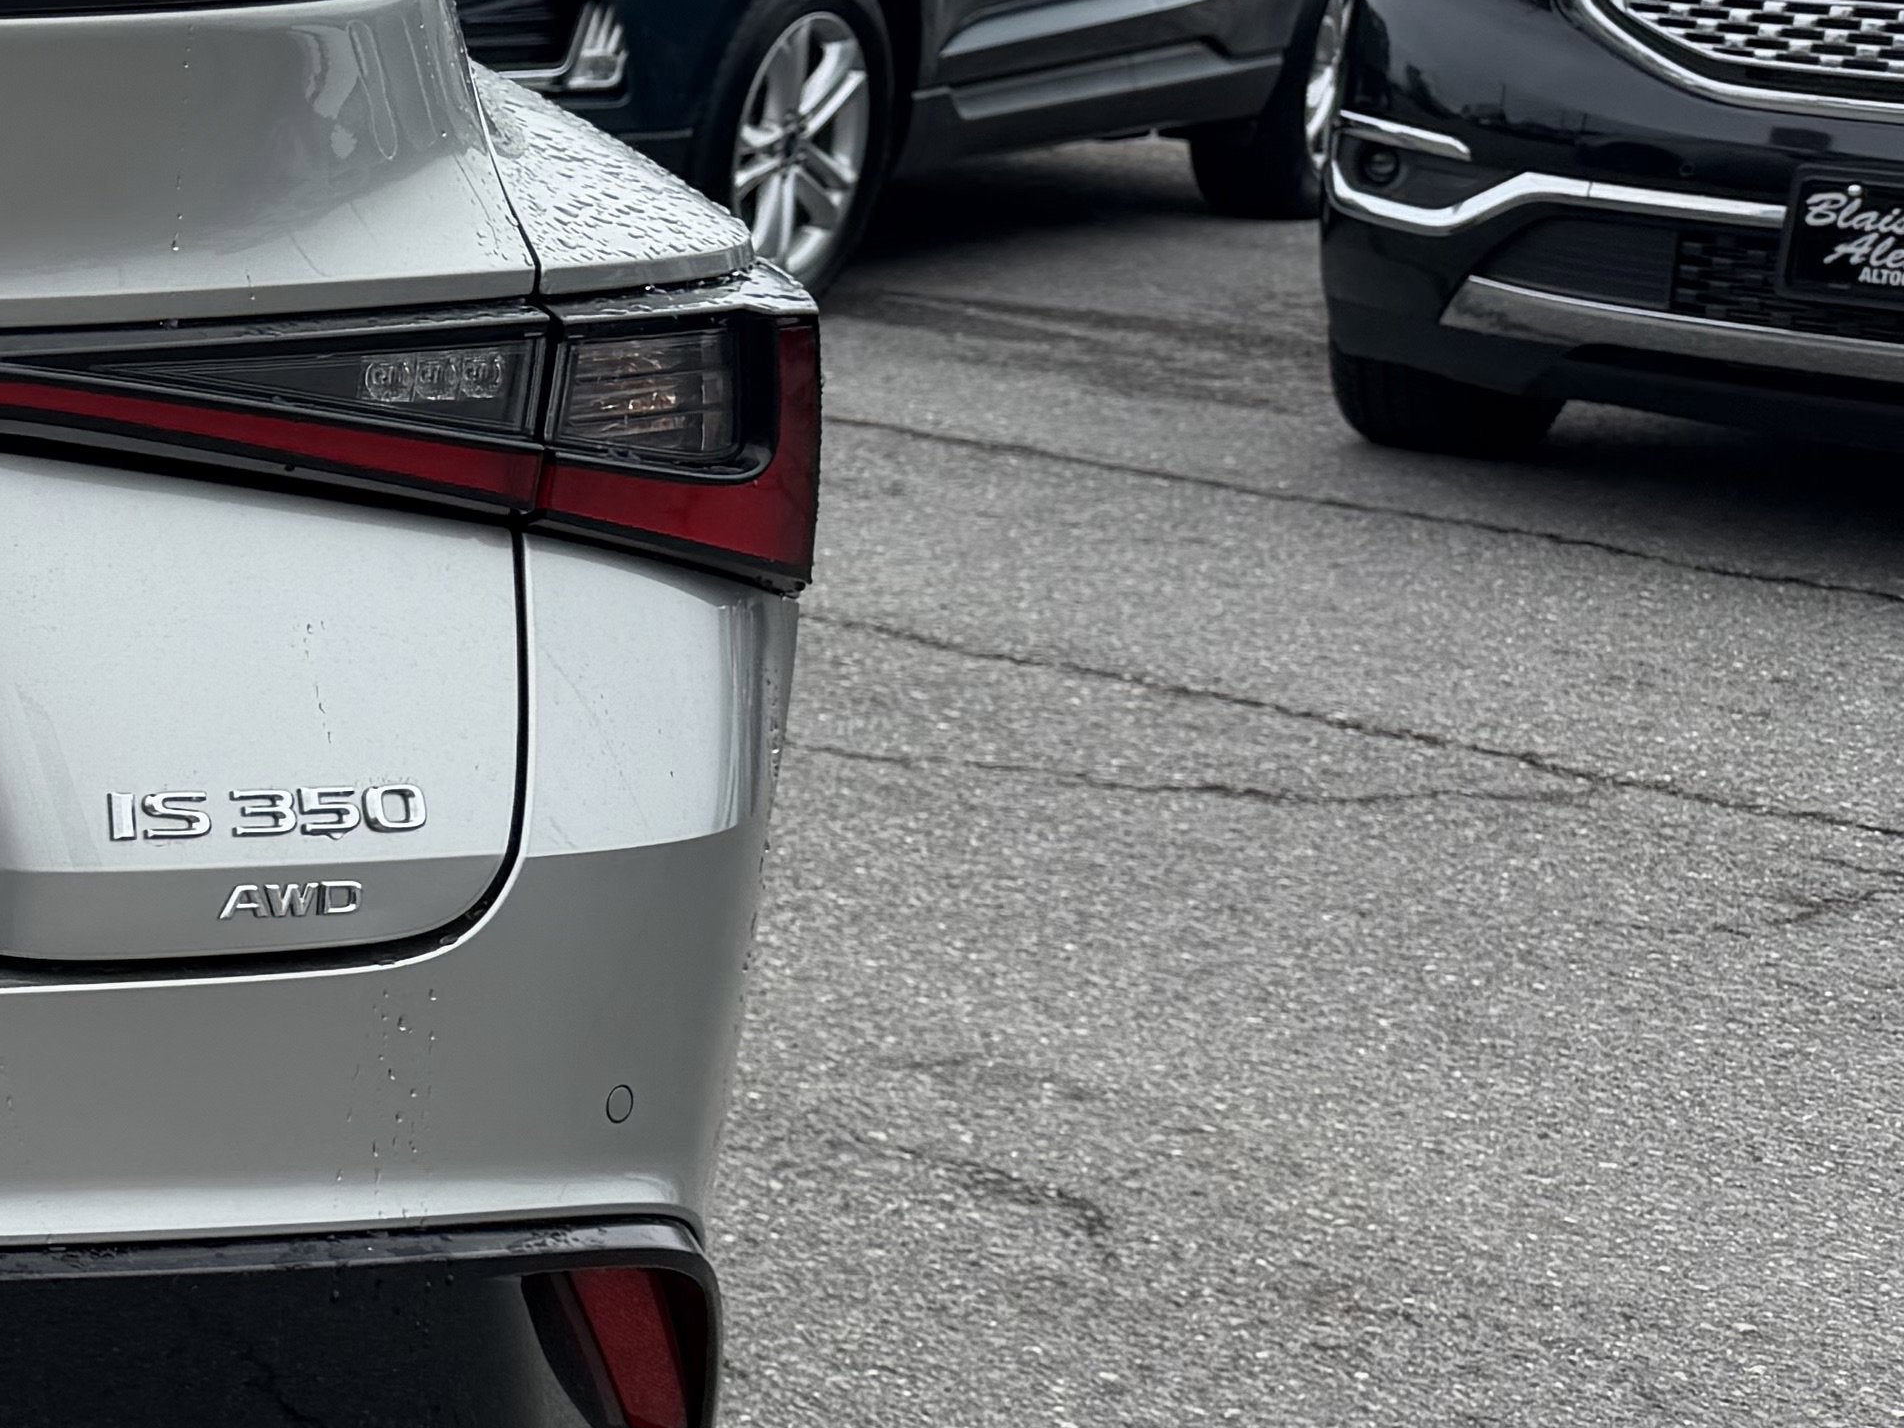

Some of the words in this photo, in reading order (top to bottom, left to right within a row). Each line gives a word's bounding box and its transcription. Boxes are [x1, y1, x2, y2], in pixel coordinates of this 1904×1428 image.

[1858, 266, 1904, 286] ALTO
[106, 790, 212, 841] IS
[229, 782, 428, 839] 350
[218, 880, 363, 921] AWD
